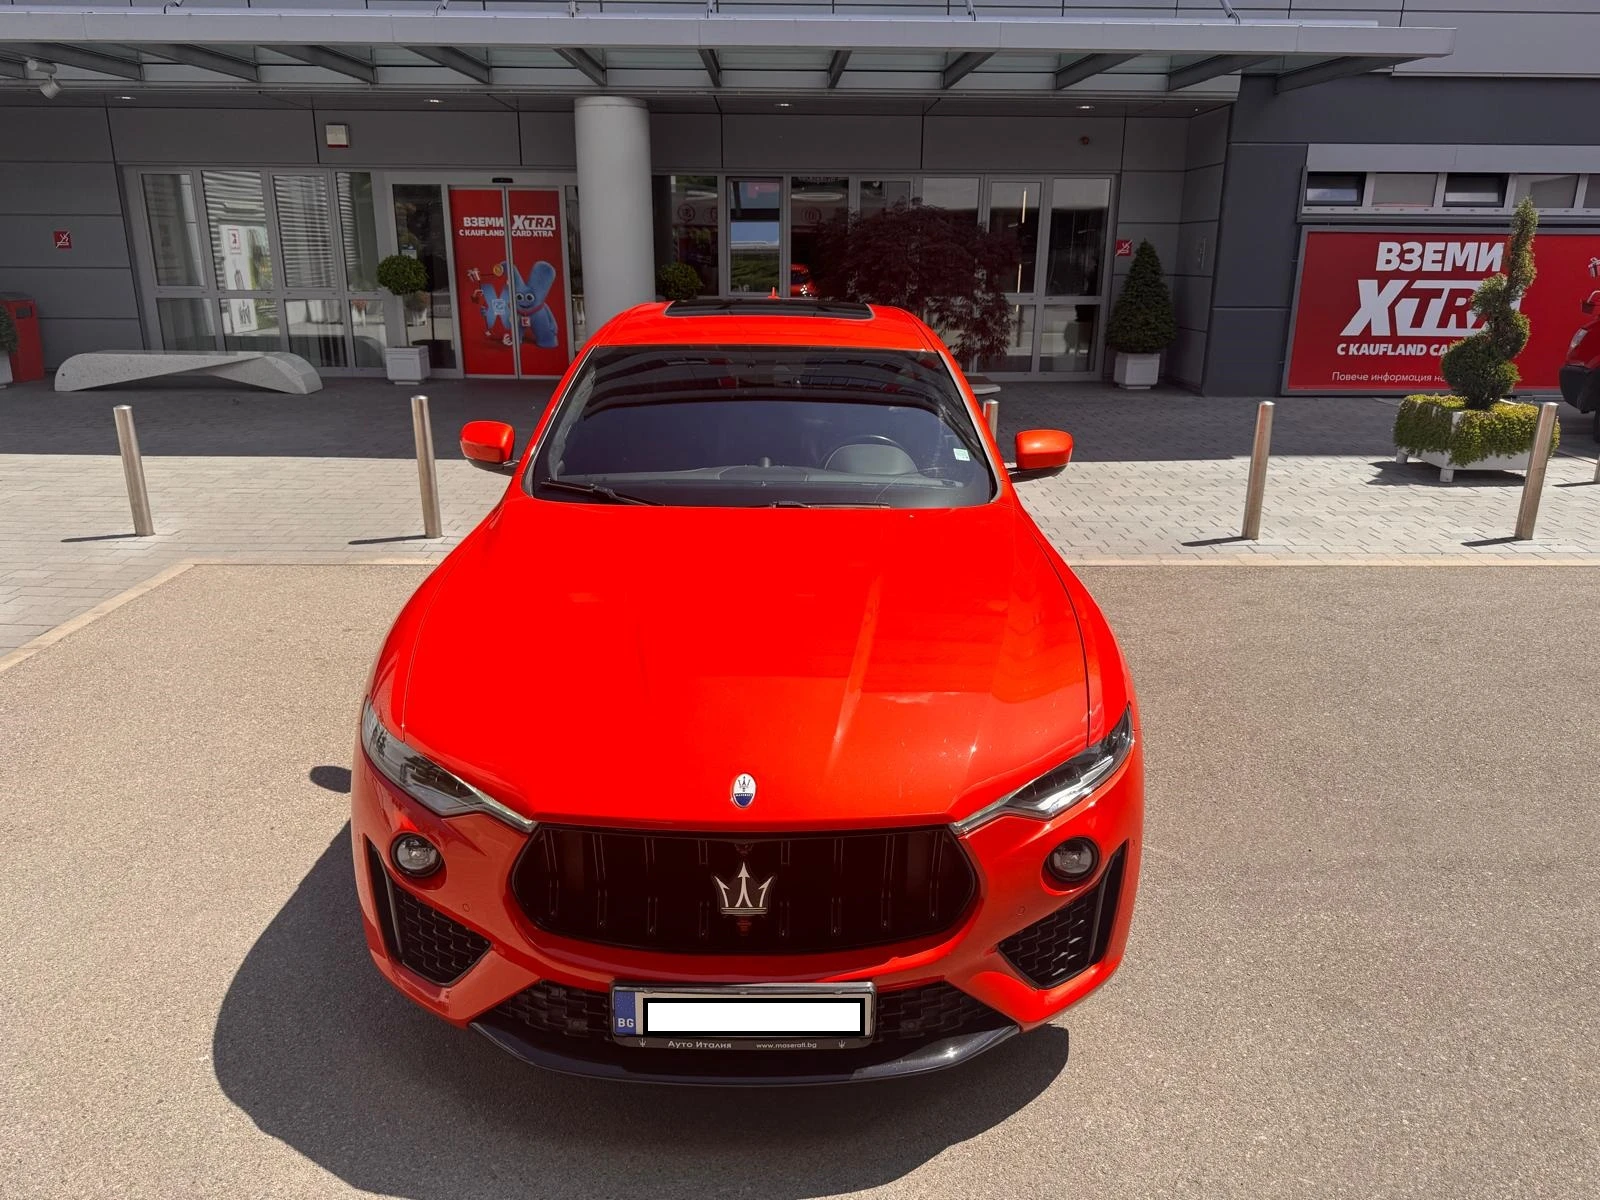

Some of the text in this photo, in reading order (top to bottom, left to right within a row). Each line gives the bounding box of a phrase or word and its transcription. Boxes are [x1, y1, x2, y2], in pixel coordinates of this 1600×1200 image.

[463, 214, 556, 230] ВЗЕМИ XTRA
[465, 229, 505, 237] KAUFLAND
[1375, 241, 1505, 272] ВЗЕМИ
[1348, 344, 1427, 356] KAUFLAND
[1429, 344, 1448, 356] CA
[1331, 371, 1369, 381] Повече
[1370, 372, 1432, 383] информация
[617, 1018, 635, 1028] BG
[667, 1040, 732, 1049] Ауто Италия
